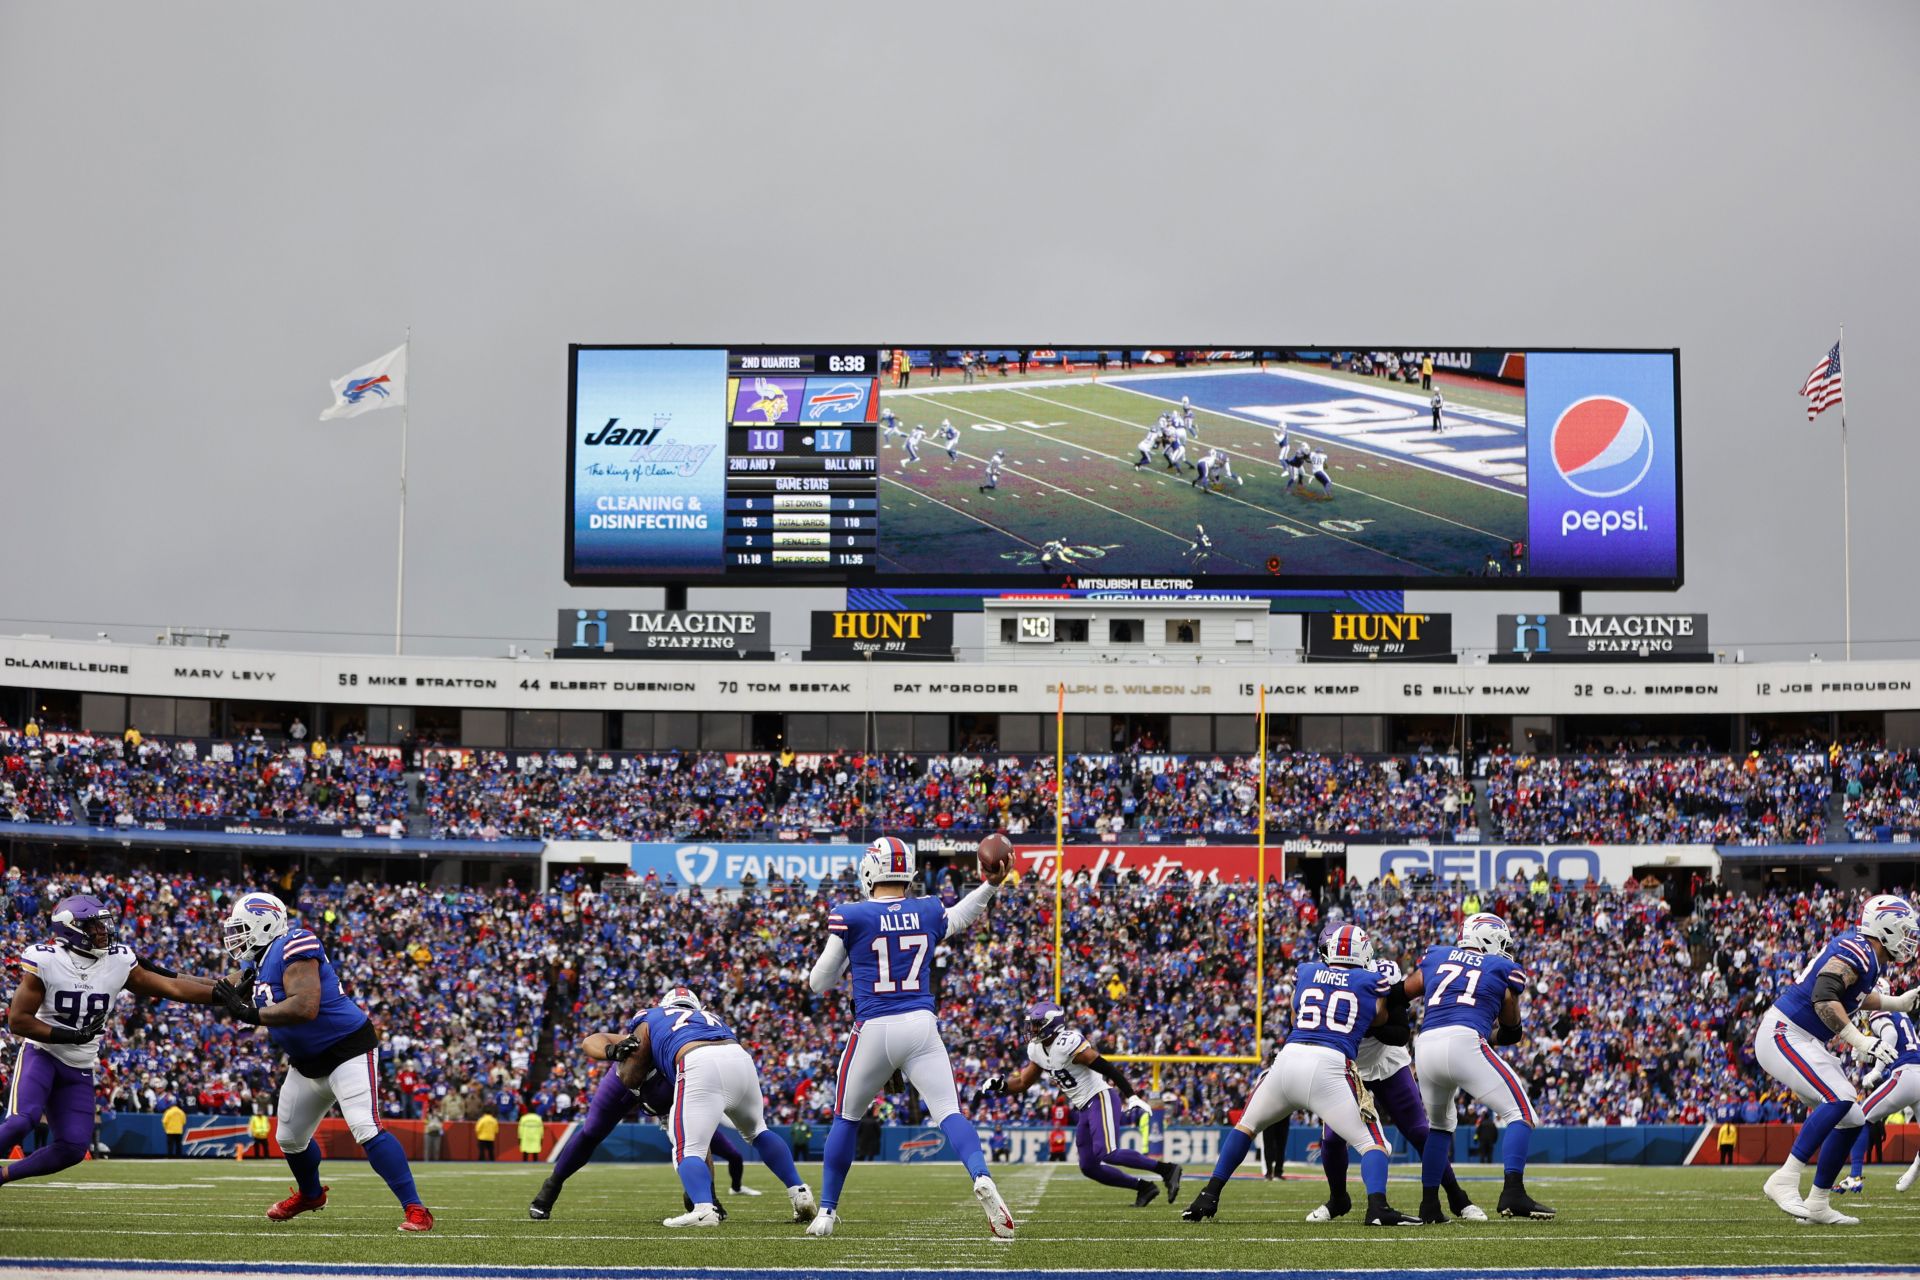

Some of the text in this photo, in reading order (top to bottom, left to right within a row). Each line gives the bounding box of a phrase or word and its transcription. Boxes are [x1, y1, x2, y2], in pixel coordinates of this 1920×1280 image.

[741, 356, 801, 369] 2ND QUARTER
[829, 355, 865, 372] 6:38
[584, 417, 662, 446] Jani
[753, 431, 779, 450] 10
[820, 431, 845, 450] 17
[729, 458, 776, 471] 2ND AND 9
[824, 458, 875, 471] BALL ON 11
[632, 463, 642, 481] of
[776, 478, 829, 491] GAME STATS
[596, 496, 702, 511] CLEANING &
[745, 498, 753, 509] 6
[795, 499, 823, 508] DOWNS
[847, 499, 855, 509] 9
[589, 514, 708, 530] DISINFECTING
[742, 517, 758, 528] 155
[778, 518, 826, 527] TOTAL YARDS
[745, 535, 753, 546] 2
[782, 538, 822, 546] PENALTIES
[847, 535, 855, 546] 0
[839, 553, 864, 565] 11:35
[1077, 579, 1194, 590] MITSUBISHI ELECTRIC
[627, 613, 756, 633] IMAGINE
[1022, 616, 1050, 638] 40
[1567, 616, 1694, 637] IMAGINE
[647, 637, 736, 649] STAFFING
[852, 641, 906, 652] Since 1911
[1352, 643, 1405, 654] Since 1911
[1587, 639, 1673, 652] STAFFING
[174, 668, 277, 682] MARV LEVY
[338, 673, 497, 689] 58 MIKE STRATTON
[519, 680, 695, 693] 44 ELBERT DUBENION
[718, 681, 851, 694] 70 TOM SESTAK
[894, 683, 922, 693] PAT
[1046, 684, 1212, 695] RALPH C. WILSON JR
[1239, 683, 1360, 696] 15 JACK KEMP
[1403, 684, 1531, 697] 66 BILLY SHAW
[1574, 684, 1719, 697] 32 O.J. SIMPSON
[1756, 681, 1912, 696] 12 JOE FERGUSON
[1380, 849, 1600, 890] GEICO
[880, 913, 919, 931] ALLEN
[871, 934, 928, 993] 17
[1448, 949, 1484, 968] BATES
[1313, 969, 1350, 987] MORSE
[1428, 964, 1482, 1007] 71
[54, 991, 110, 1030] 98
[1297, 987, 1359, 1034] 60
